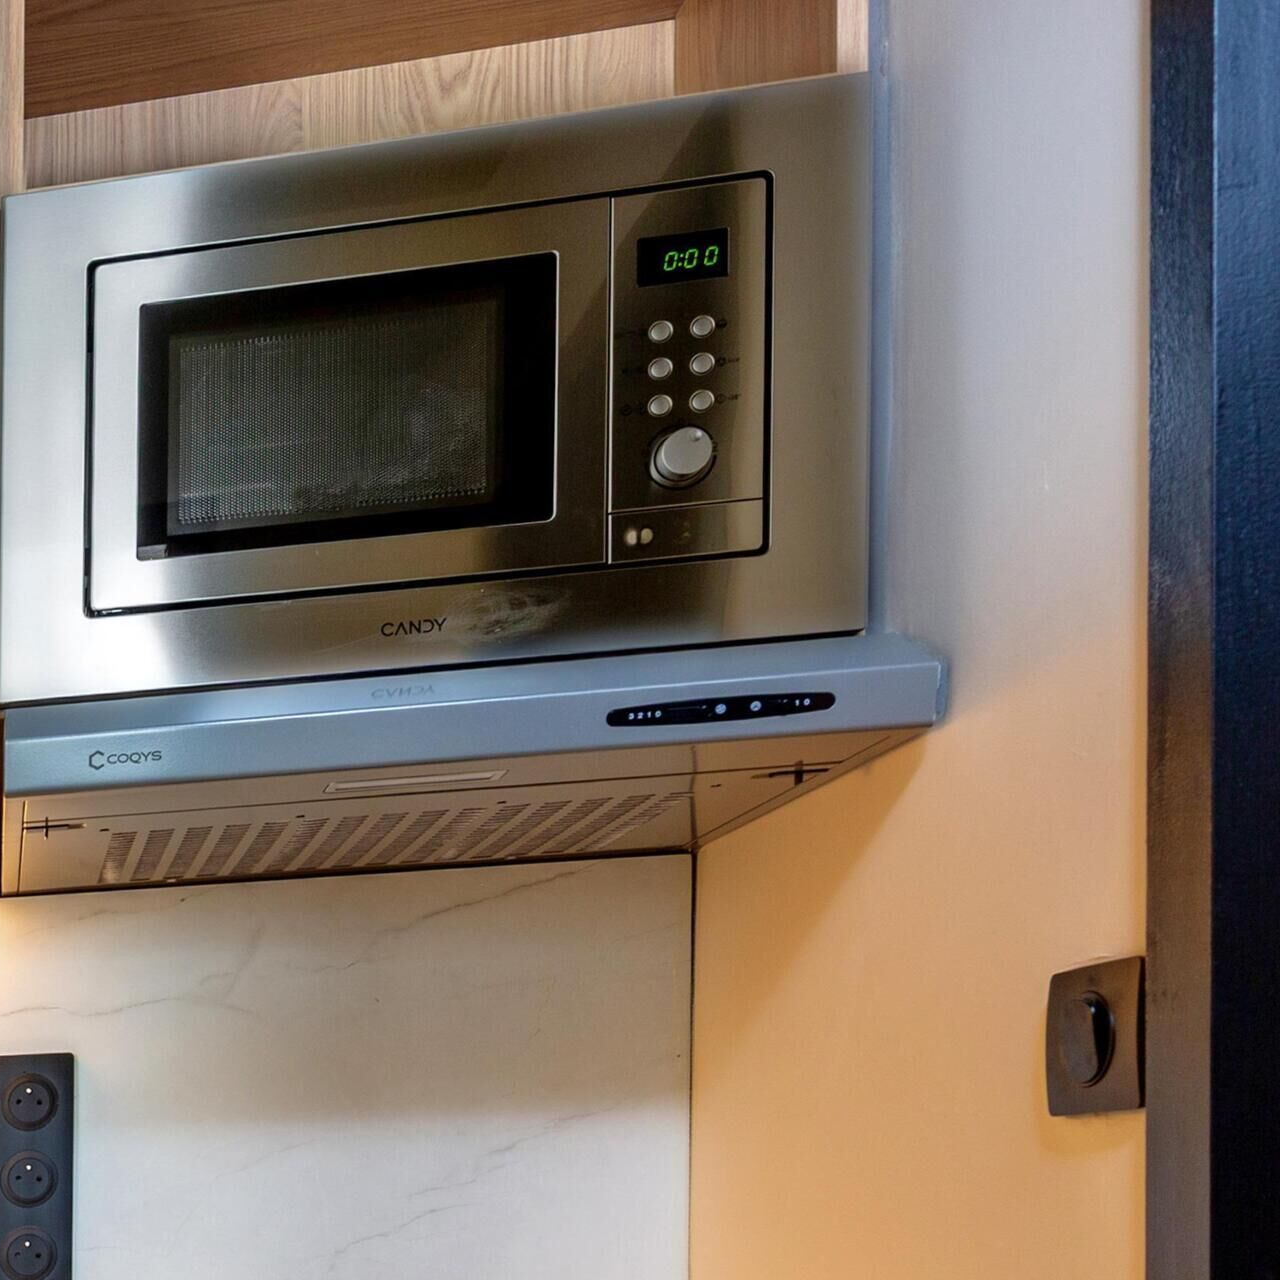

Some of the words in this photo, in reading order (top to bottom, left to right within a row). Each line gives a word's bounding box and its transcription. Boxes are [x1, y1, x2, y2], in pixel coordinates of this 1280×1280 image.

[663, 246, 719, 271] 0:00
[381, 618, 447, 637] CANDY
[106, 750, 162, 765] COQYS
